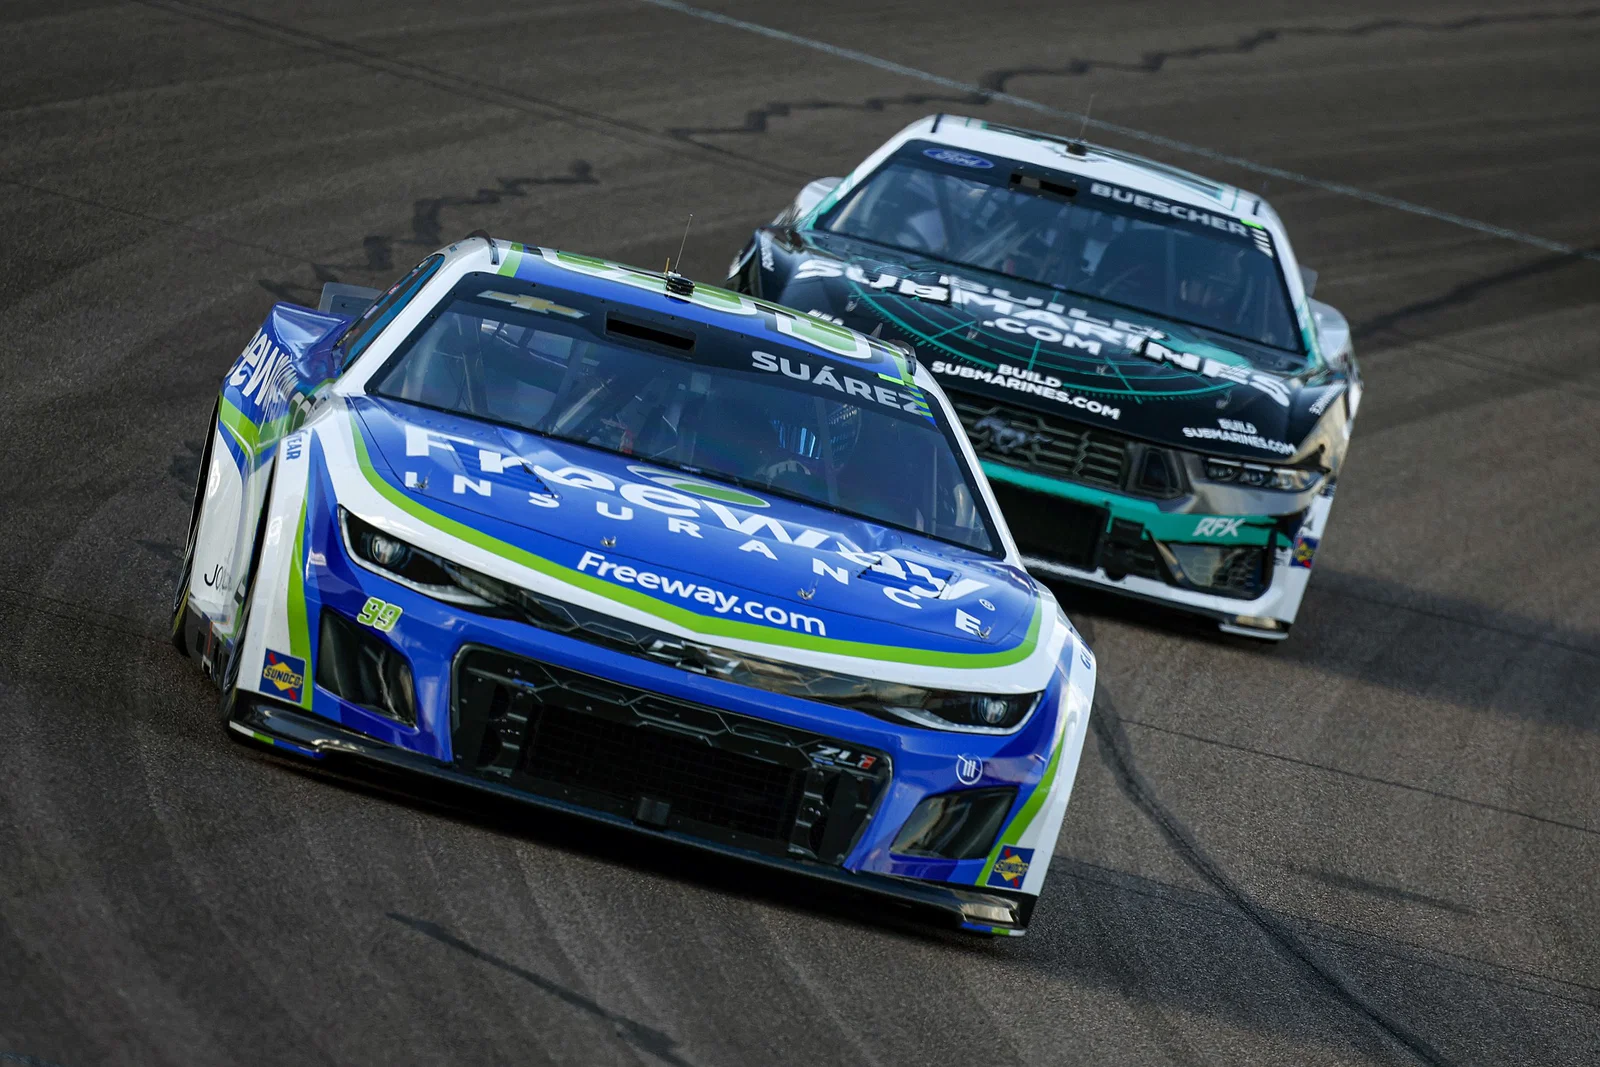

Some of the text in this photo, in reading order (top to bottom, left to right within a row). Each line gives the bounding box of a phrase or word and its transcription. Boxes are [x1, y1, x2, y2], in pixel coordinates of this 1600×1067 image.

[1090, 182, 1249, 237] BUESCHER
[795, 258, 1291, 407] SUBMARINES
[751, 350, 923, 416] SUÁREZ
[931, 360, 1121, 421] SUBMARINES.COM
[998, 363, 1062, 388] BUILD
[1182, 427, 1297, 455] SUBMARINES.COM
[1217, 418, 1258, 436] BUILD
[405, 424, 989, 601] Freeway
[1192, 517, 1246, 538] RFK
[405, 471, 982, 634] INSURANCE
[357, 597, 403, 633] 99
[576, 550, 827, 636] Freeway.com
[264, 666, 303, 689] SUNOCO
[810, 744, 877, 770] ZL1
